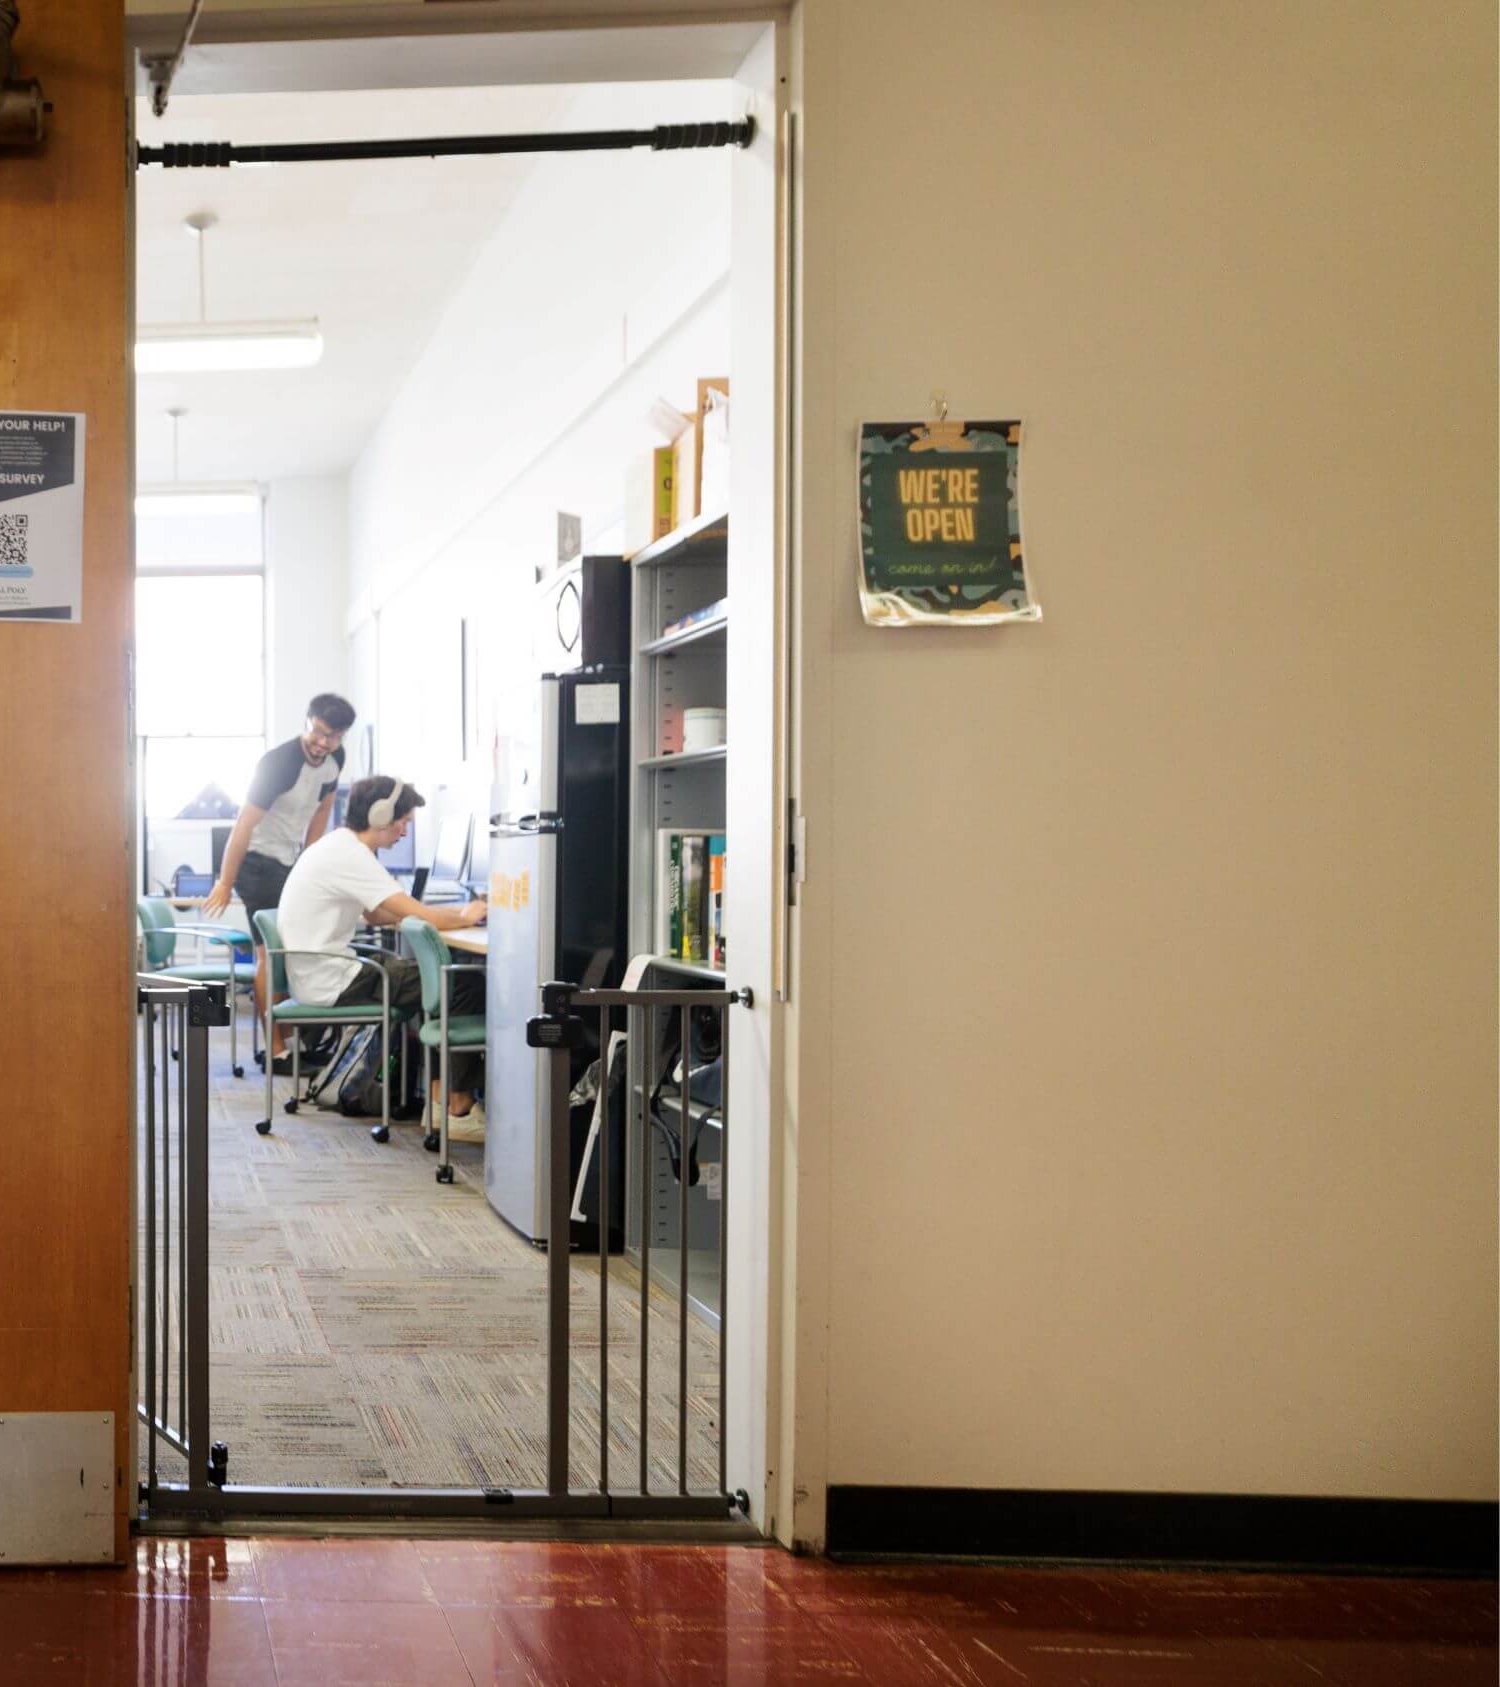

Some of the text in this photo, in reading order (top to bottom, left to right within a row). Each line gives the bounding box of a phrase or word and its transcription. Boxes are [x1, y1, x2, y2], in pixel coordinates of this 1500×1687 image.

[33, 421, 65, 432] HELP!
[0, 473, 45, 485] SURVEY
[898, 468, 979, 503] WE'RE
[906, 507, 975, 542] OPEN
